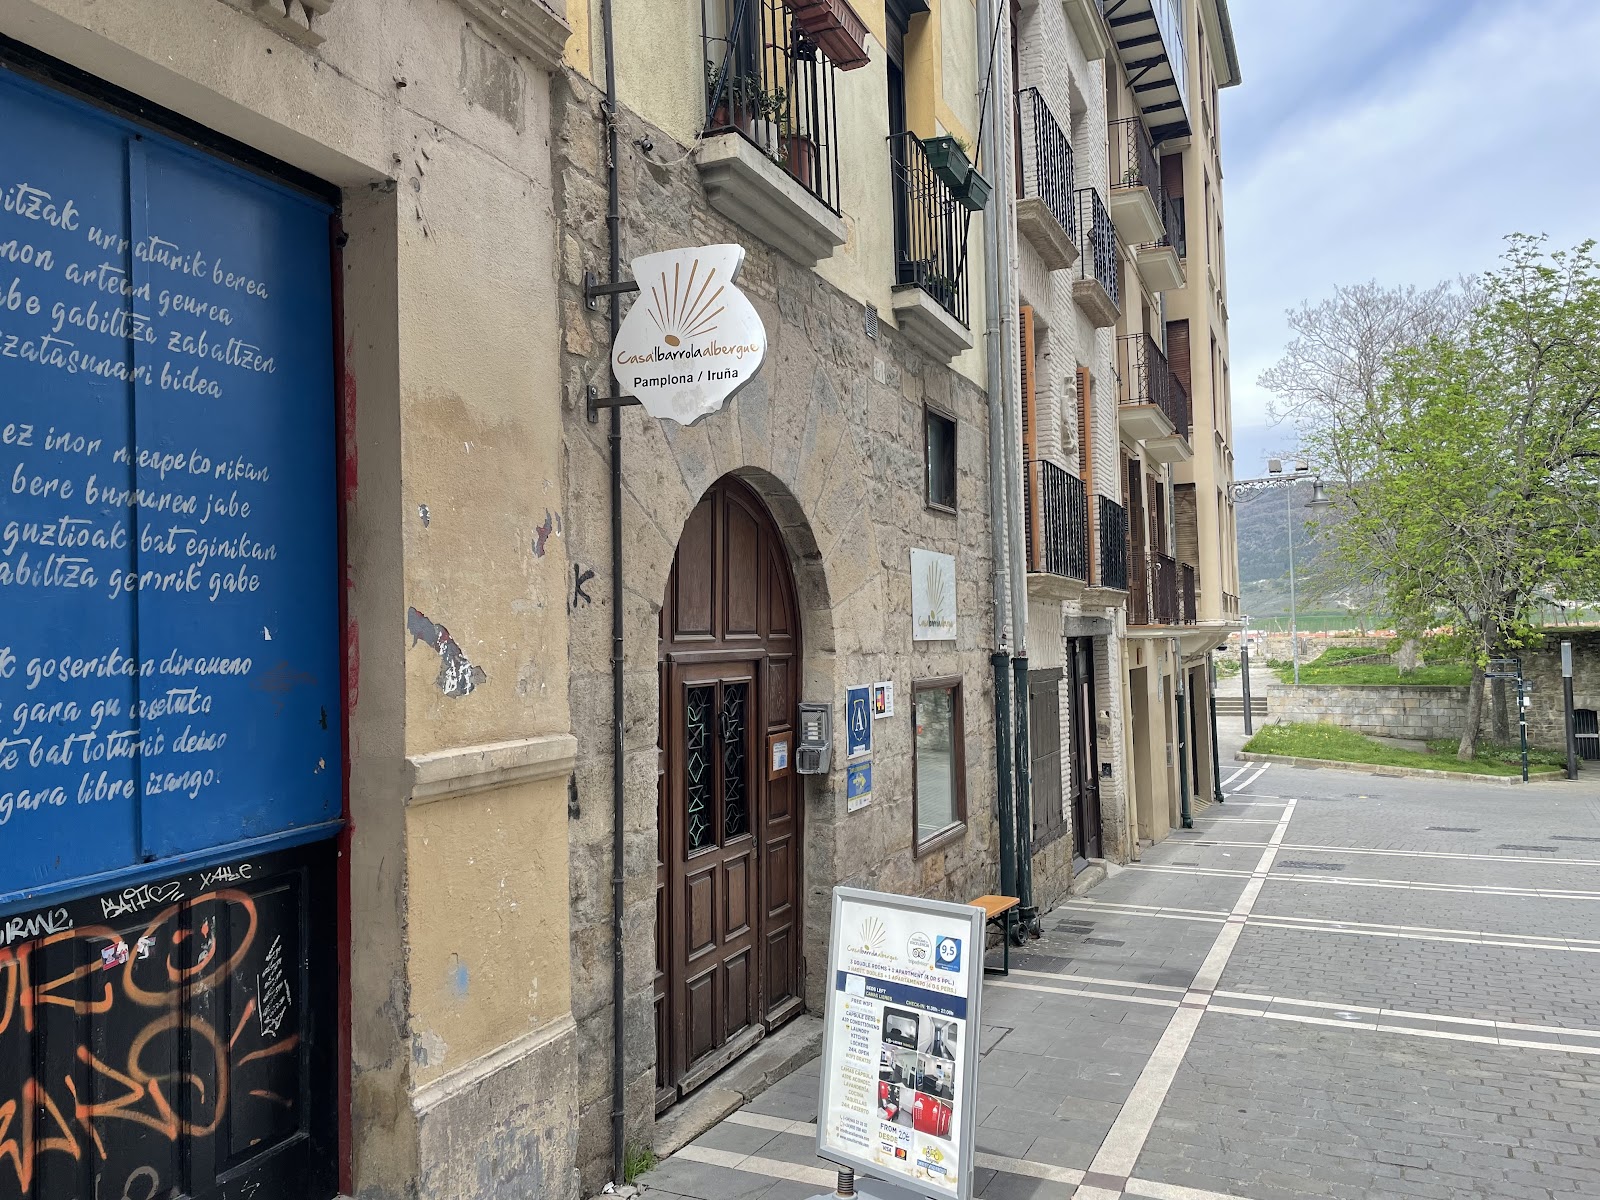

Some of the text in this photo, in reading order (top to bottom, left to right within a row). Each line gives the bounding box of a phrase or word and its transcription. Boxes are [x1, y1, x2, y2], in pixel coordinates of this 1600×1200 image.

[0, 182, 79, 231] itzak
[213, 258, 268, 300] berea
[65, 262, 151, 302] artean
[159, 289, 233, 326] geurea
[52, 300, 157, 345] gabiltza
[168, 330, 277, 374] zabaltzen
[160, 361, 222, 398] bidea
[633, 368, 739, 387] Pamplona / Iruña
[2, 422, 34, 447] ez
[44, 426, 101, 456] inon
[11, 462, 74, 499] bere
[200, 490, 251, 524] jabe
[4, 518, 277, 567] guztioak bat eginikan
[209, 564, 260, 601] gabe
[573, 563, 594, 607] K
[26, 647, 155, 690] goserikan
[13, 701, 81, 735] gara
[91, 698, 121, 730] gu
[853, 706, 865, 732] A
[0, 786, 67, 825] gara
[78, 770, 134, 806] libre
[941, 945, 955, 957] 9,5
[892, 976, 926, 987] APARTAMENTO
[896, 968, 924, 979] APARTMENT
[850, 1018, 880, 1030] CONDITIONING
[850, 1026, 870, 1034] LAUNDRY
[850, 1032, 869, 1042] KITCHEN
[878, 1132, 898, 1144] DESDE
[880, 1122, 897, 1134] FROM
